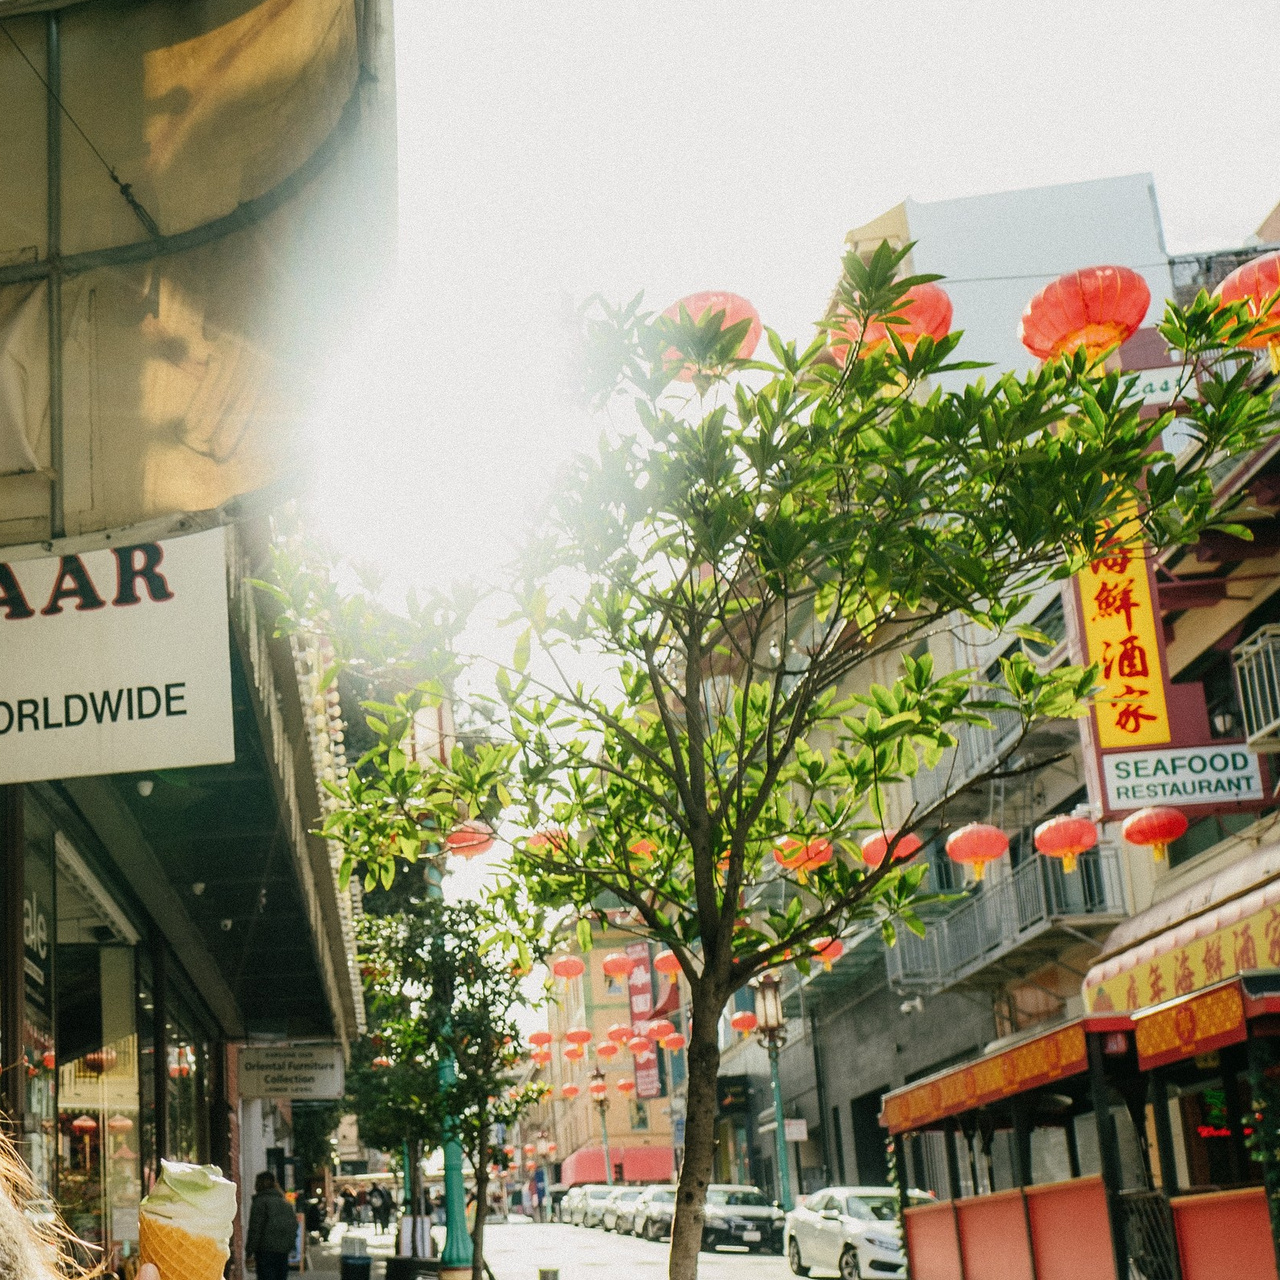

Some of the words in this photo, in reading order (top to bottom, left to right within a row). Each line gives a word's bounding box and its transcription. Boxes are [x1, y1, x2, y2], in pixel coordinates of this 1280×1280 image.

[1114, 751, 1249, 780] SEAFOOD
[1115, 776, 1254, 800] RESTAURANT
[23, 892, 48, 960] ale
[244, 1060, 285, 1071] Oriental
[288, 1060, 335, 1071] Furniture
[264, 1074, 315, 1084] Collection
